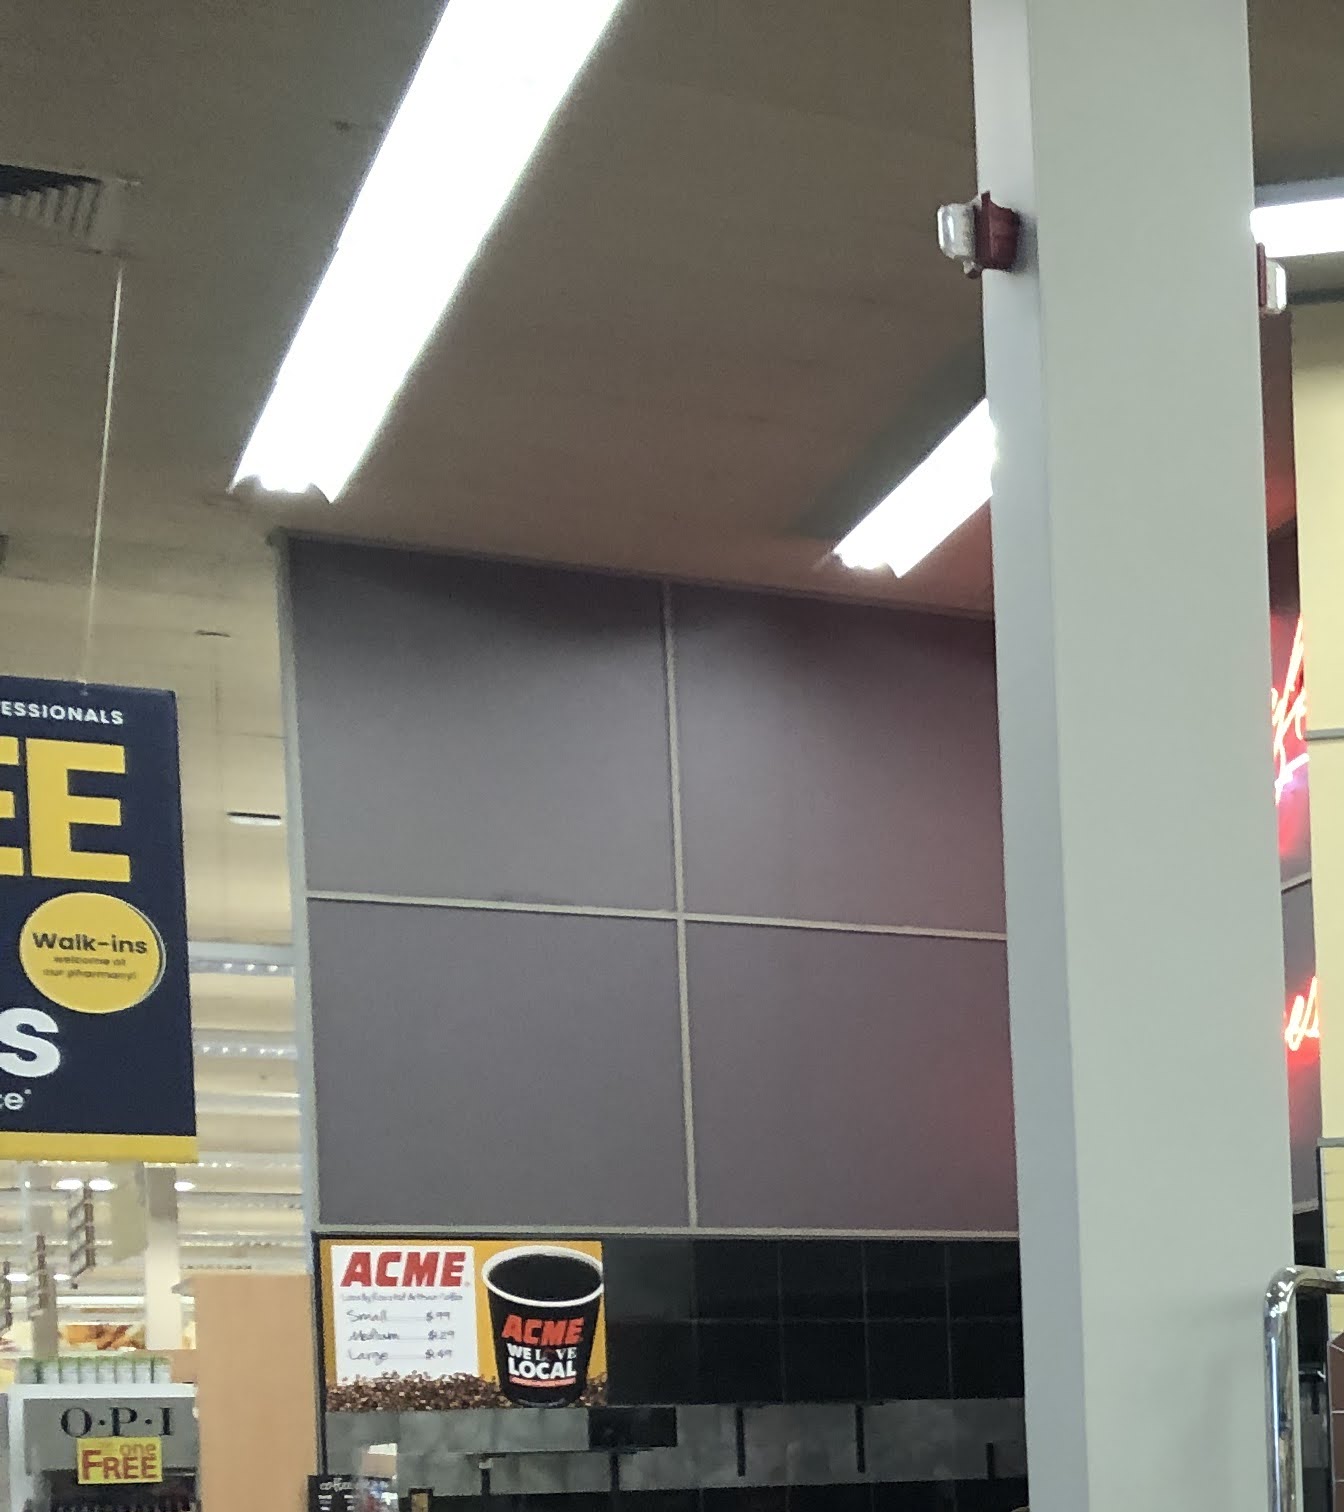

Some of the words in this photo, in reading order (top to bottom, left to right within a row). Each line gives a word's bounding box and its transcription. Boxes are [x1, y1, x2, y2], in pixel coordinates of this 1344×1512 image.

[32, 931, 148, 955] Walk-ins
[340, 1251, 467, 1288] ACME
[346, 1309, 388, 1323] Small
[502, 1315, 586, 1346] ACME
[347, 1348, 389, 1367] Large
[507, 1343, 533, 1361] WE
[507, 1359, 578, 1381] LOCAL
[81, 1449, 158, 1481] FREE
